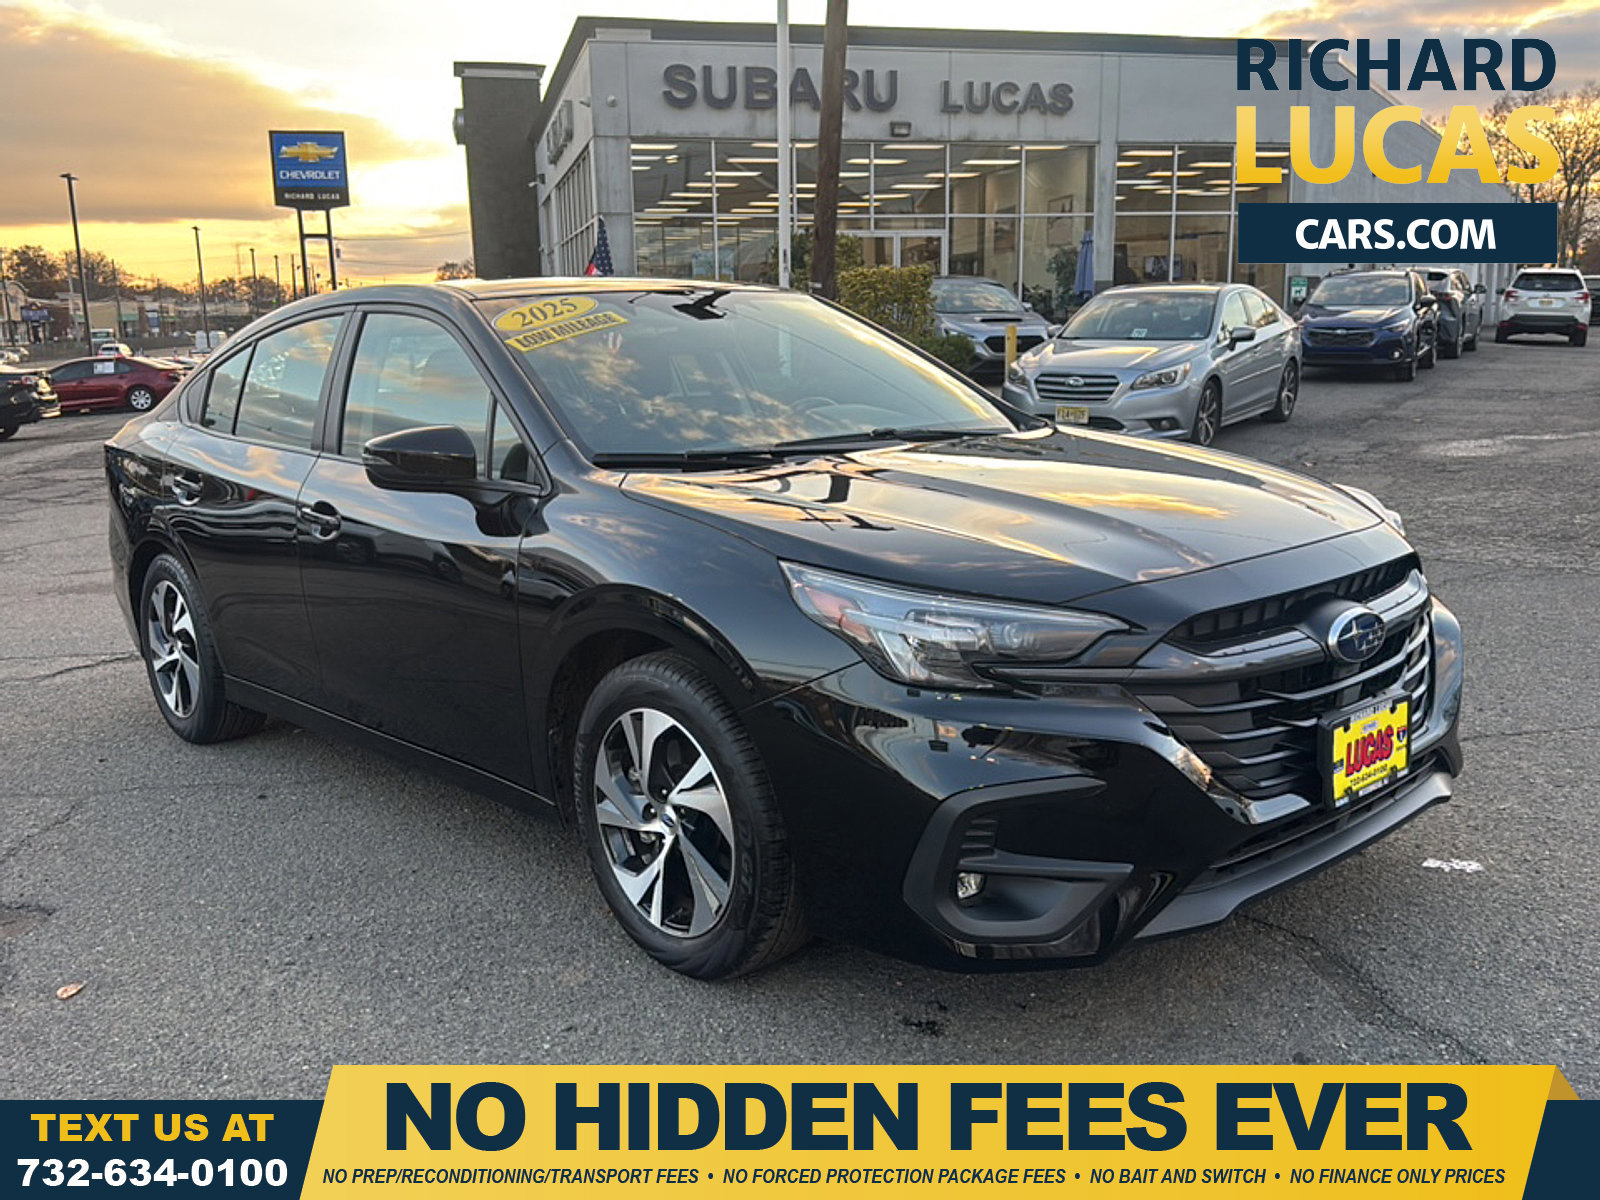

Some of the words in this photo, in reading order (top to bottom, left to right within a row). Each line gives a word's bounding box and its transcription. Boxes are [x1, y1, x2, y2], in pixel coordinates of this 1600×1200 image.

[662, 63, 899, 113] SUBARU
[940, 80, 1075, 116] LUCAS
[279, 169, 340, 180] CHEVROLET
[284, 191, 315, 200] RICHARD
[317, 192, 340, 200] LUCAS
[511, 298, 578, 328] 2025
[514, 328, 558, 348] LOW
[550, 312, 617, 337] MILEAGE
[1345, 724, 1395, 778] LUCAS
